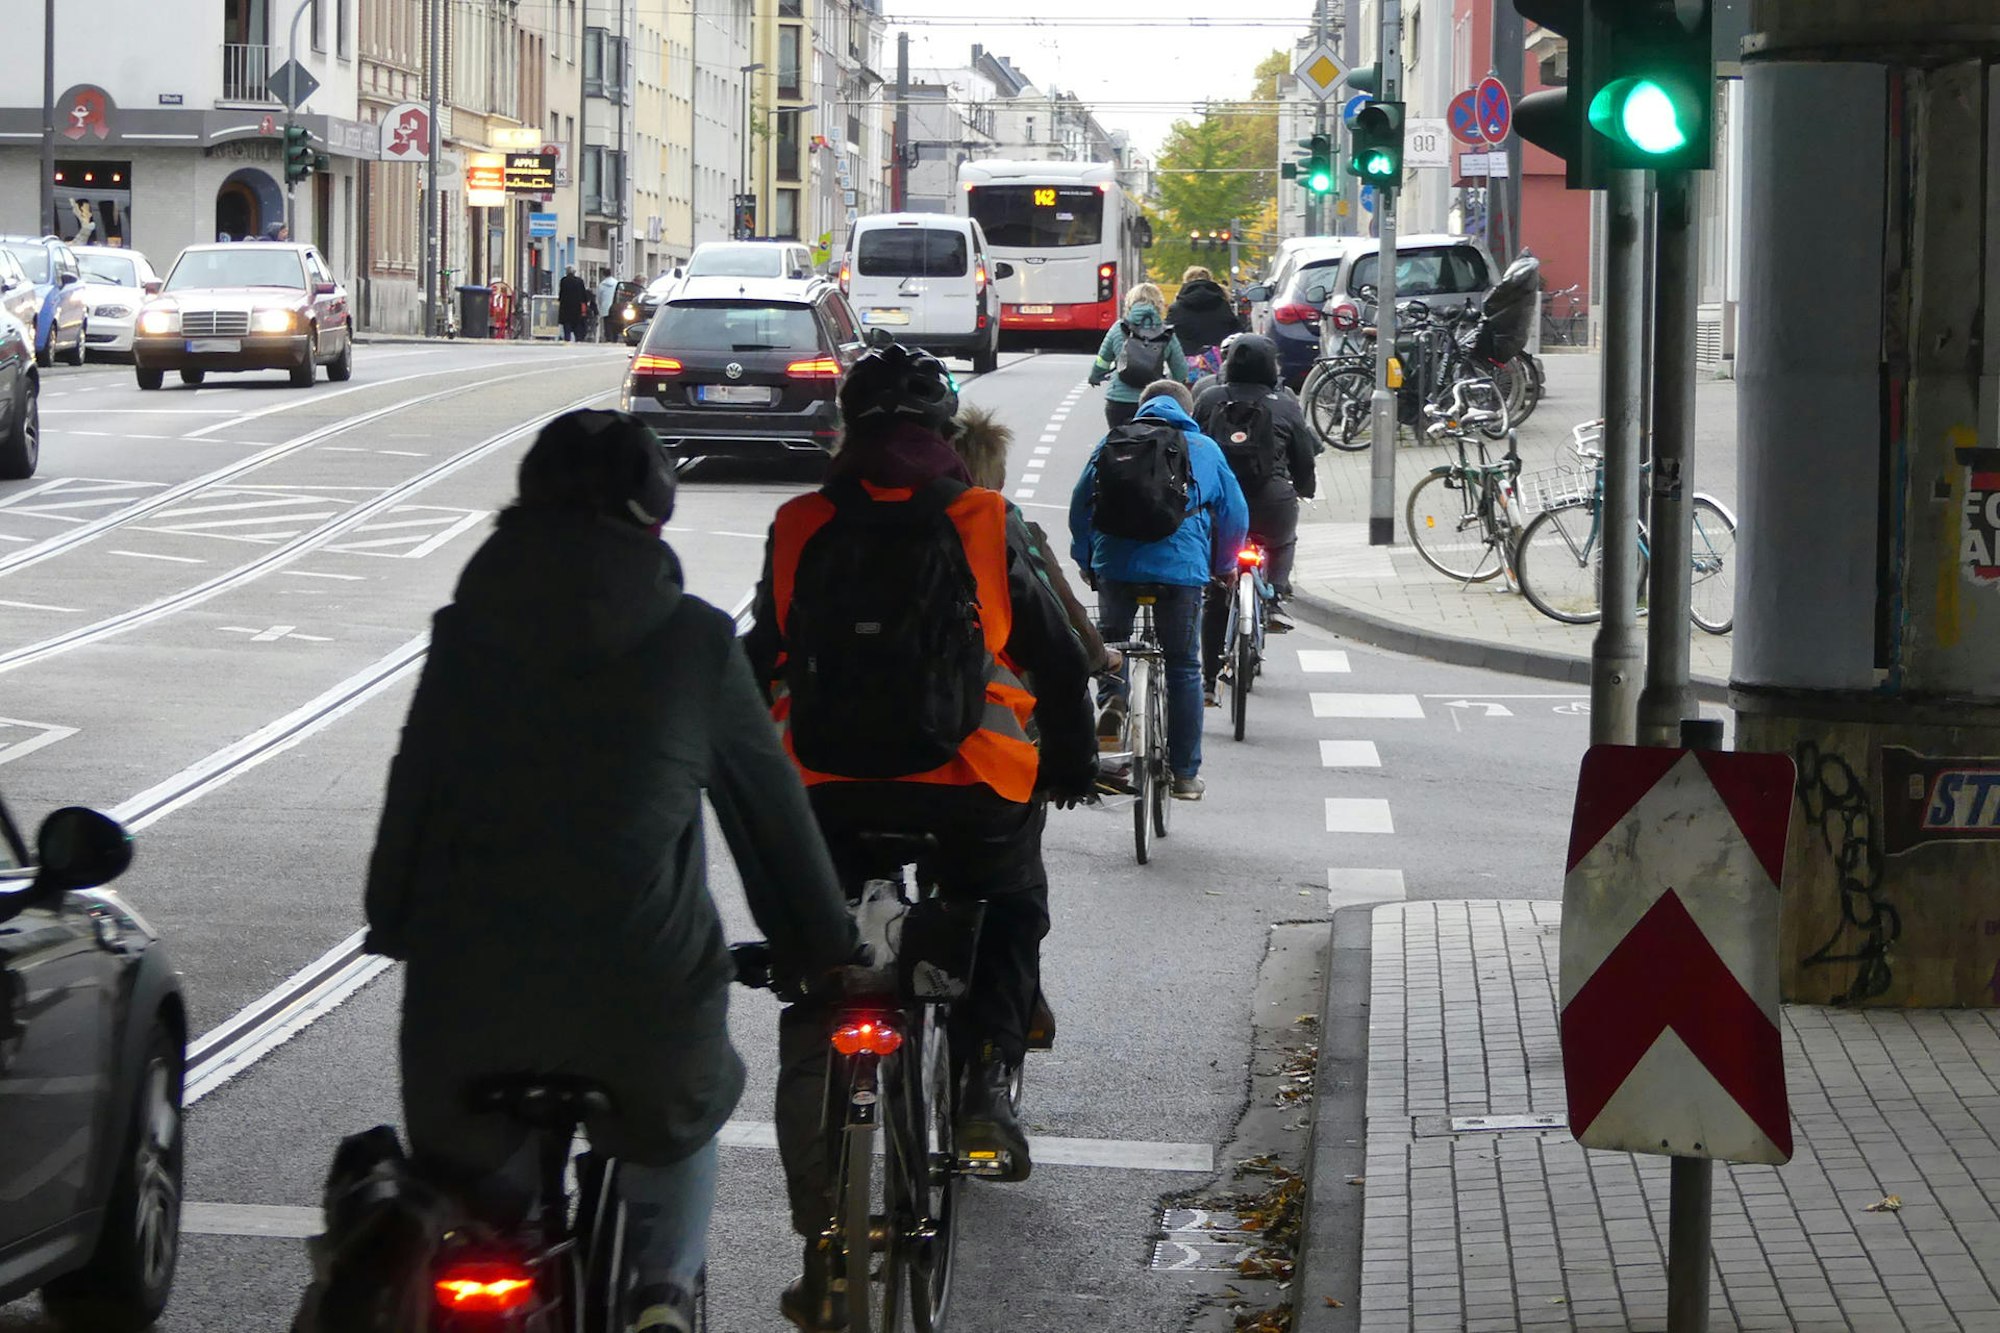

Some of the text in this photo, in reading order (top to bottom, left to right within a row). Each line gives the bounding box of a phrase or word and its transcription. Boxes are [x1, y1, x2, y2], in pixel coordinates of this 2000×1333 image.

[513, 158, 540, 168] APPLE
[1033, 188, 1056, 206] 142
[1929, 773, 2000, 827] ST
